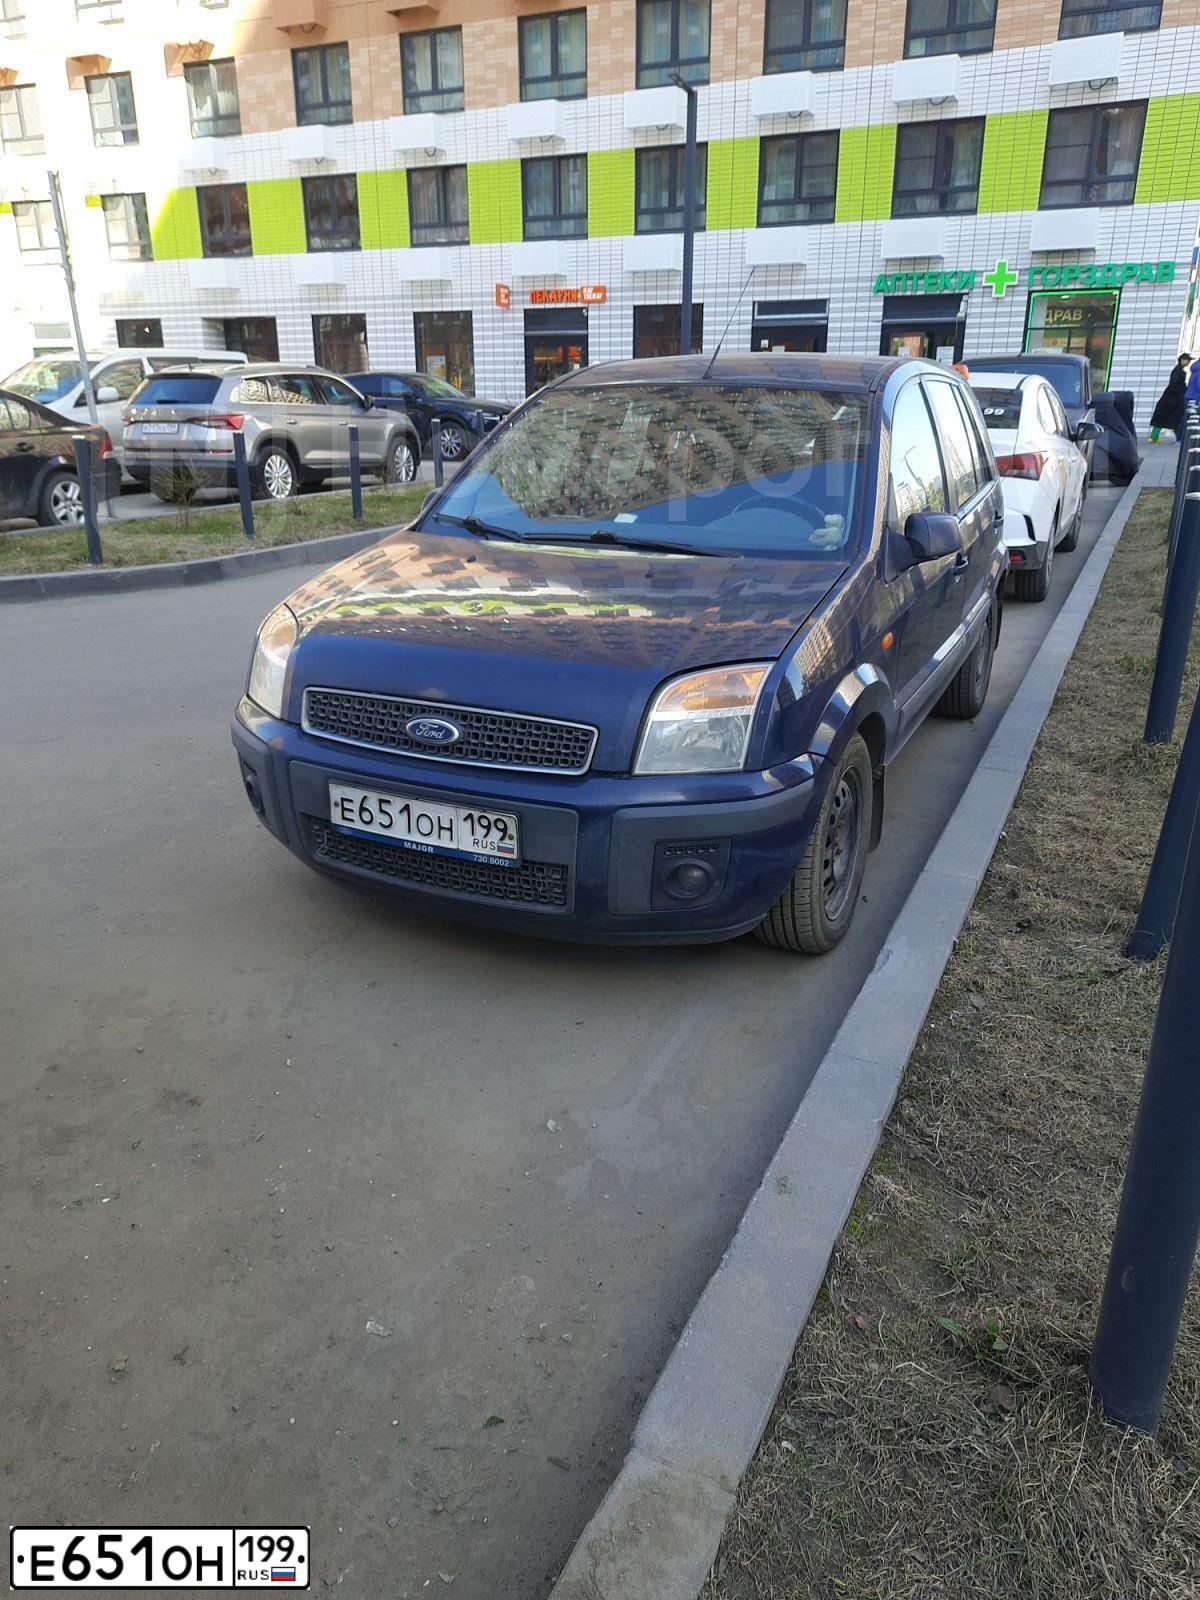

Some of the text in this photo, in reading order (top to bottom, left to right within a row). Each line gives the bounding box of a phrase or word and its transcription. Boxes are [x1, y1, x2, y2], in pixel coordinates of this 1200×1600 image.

[872, 261, 1176, 294] АПТЕКИ ГОРЗДРАВ
[415, 722, 446, 740] Ford
[340, 795, 509, 842] Е651ОН 199
[403, 841, 434, 854] MAJOR
[473, 838, 497, 851] RUS
[473, 854, 510, 868] 730 8002
